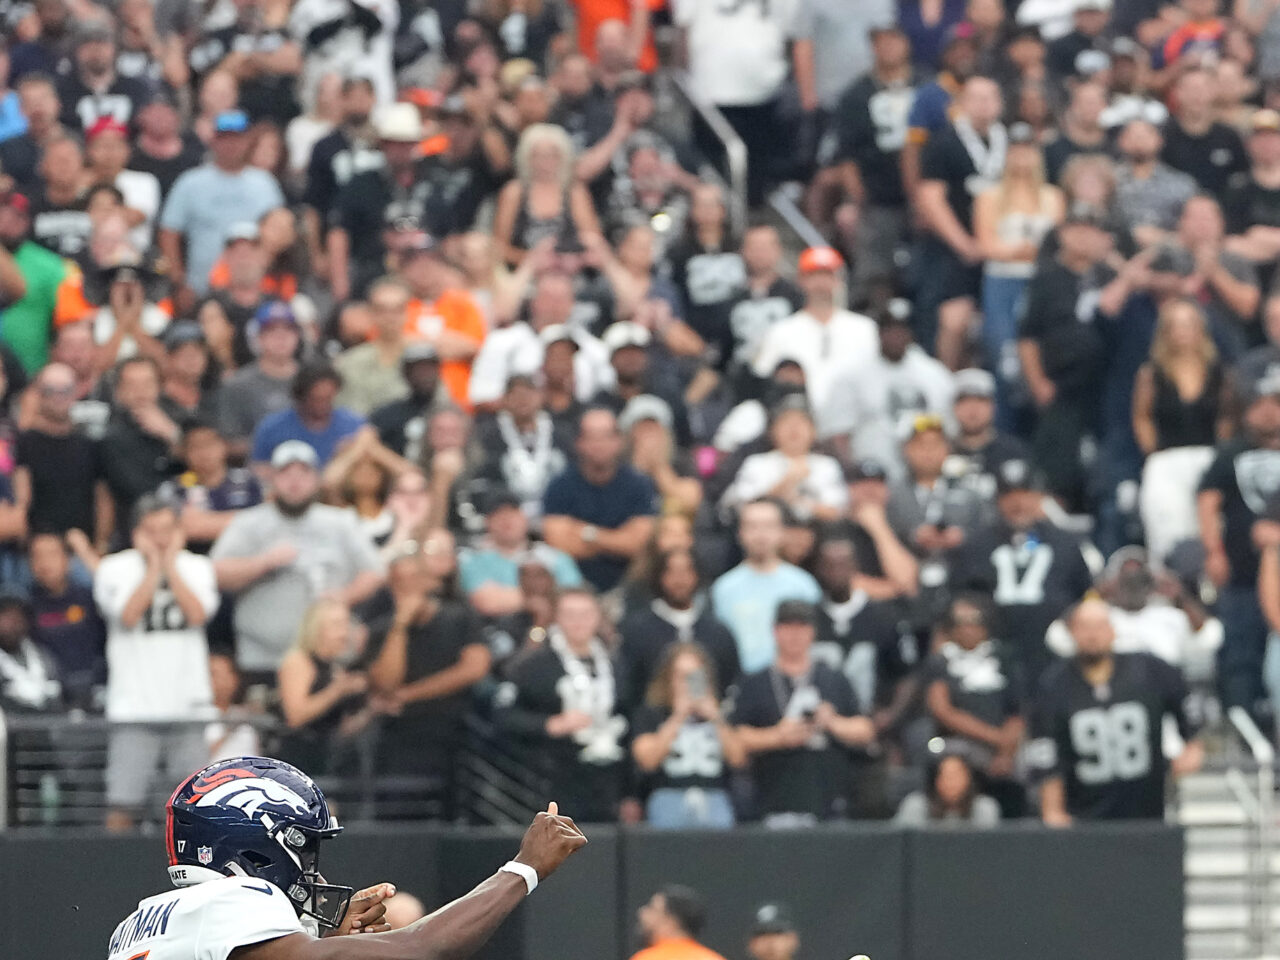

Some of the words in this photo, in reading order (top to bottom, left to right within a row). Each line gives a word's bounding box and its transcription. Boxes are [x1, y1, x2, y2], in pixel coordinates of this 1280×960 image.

[991, 543, 1053, 604] 17
[1069, 701, 1149, 786] 98
[178, 840, 186, 853] 17
[109, 898, 180, 955] AITMAN
